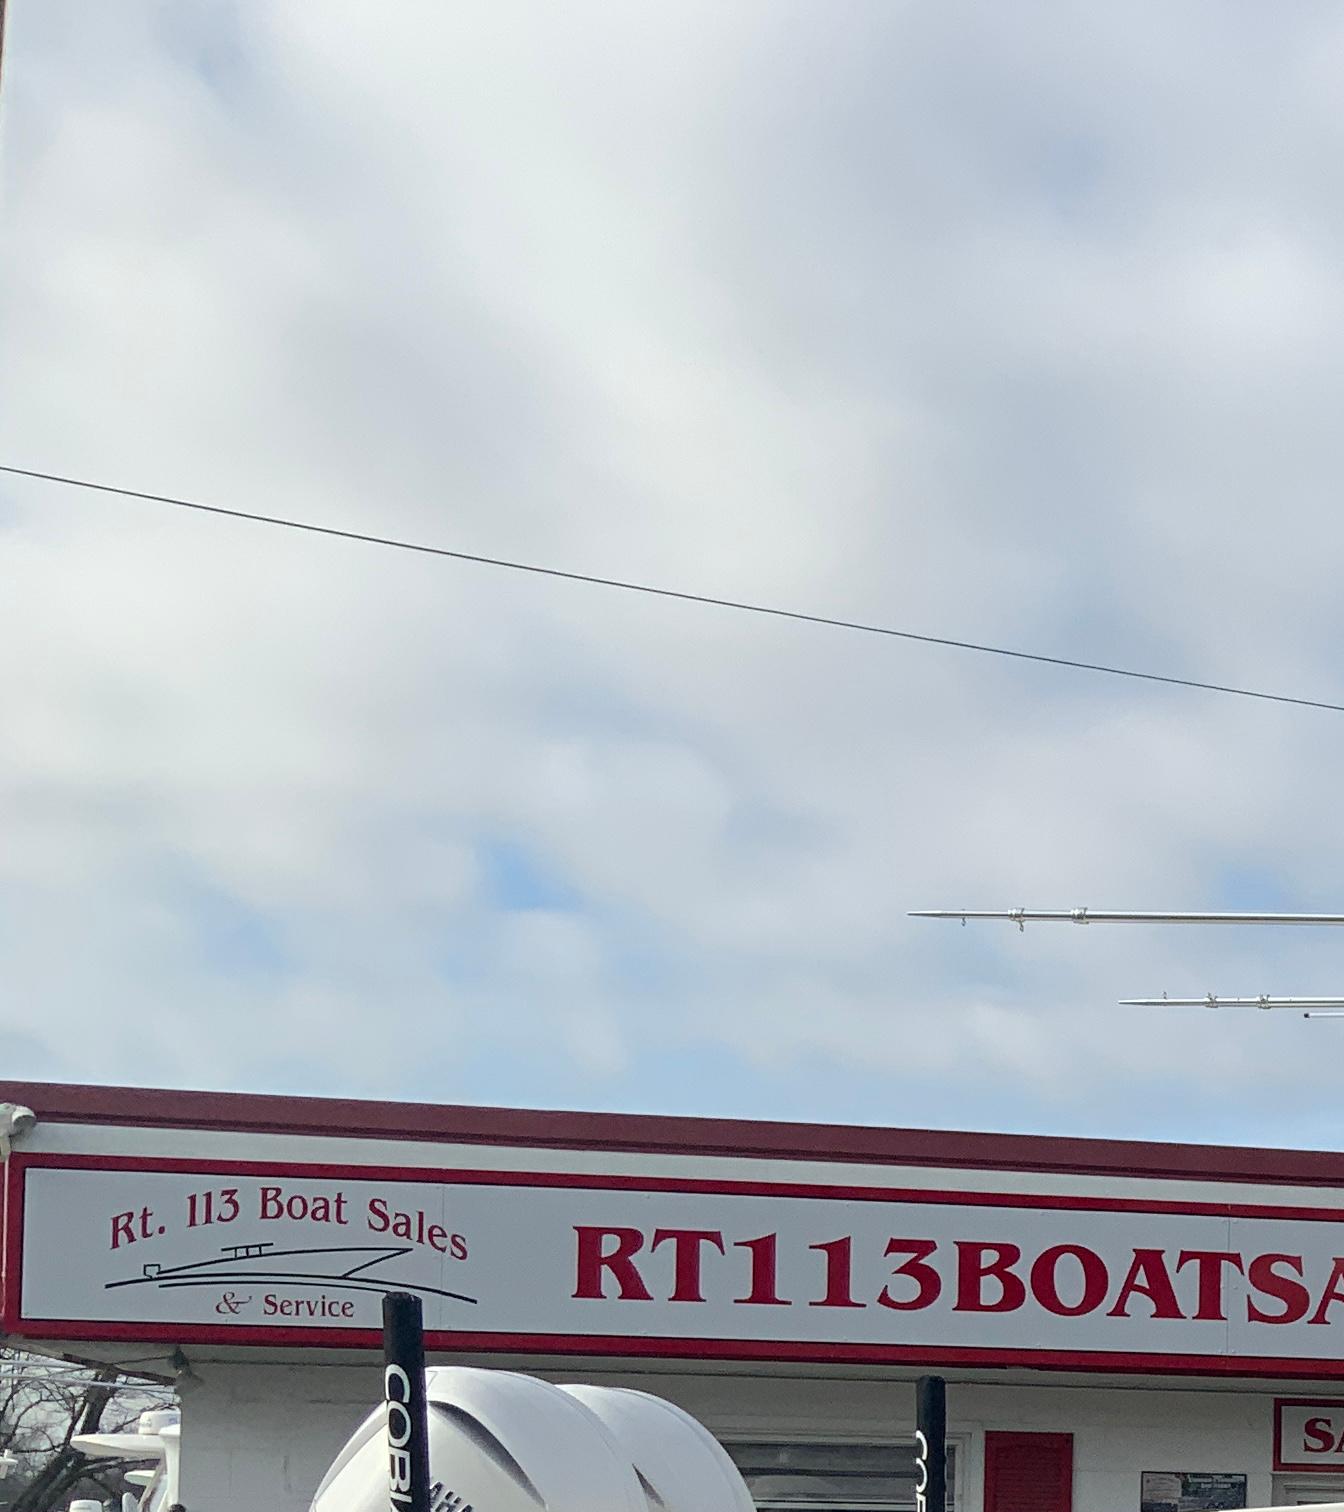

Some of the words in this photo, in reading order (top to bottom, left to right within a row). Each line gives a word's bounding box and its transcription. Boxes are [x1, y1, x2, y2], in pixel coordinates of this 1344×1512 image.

[110, 1206, 166, 1250] Rt.
[187, 1188, 240, 1228] 113
[259, 1187, 349, 1226] Boat
[367, 1198, 469, 1261] Sales
[215, 1291, 252, 1315] &
[263, 1293, 355, 1318] Service
